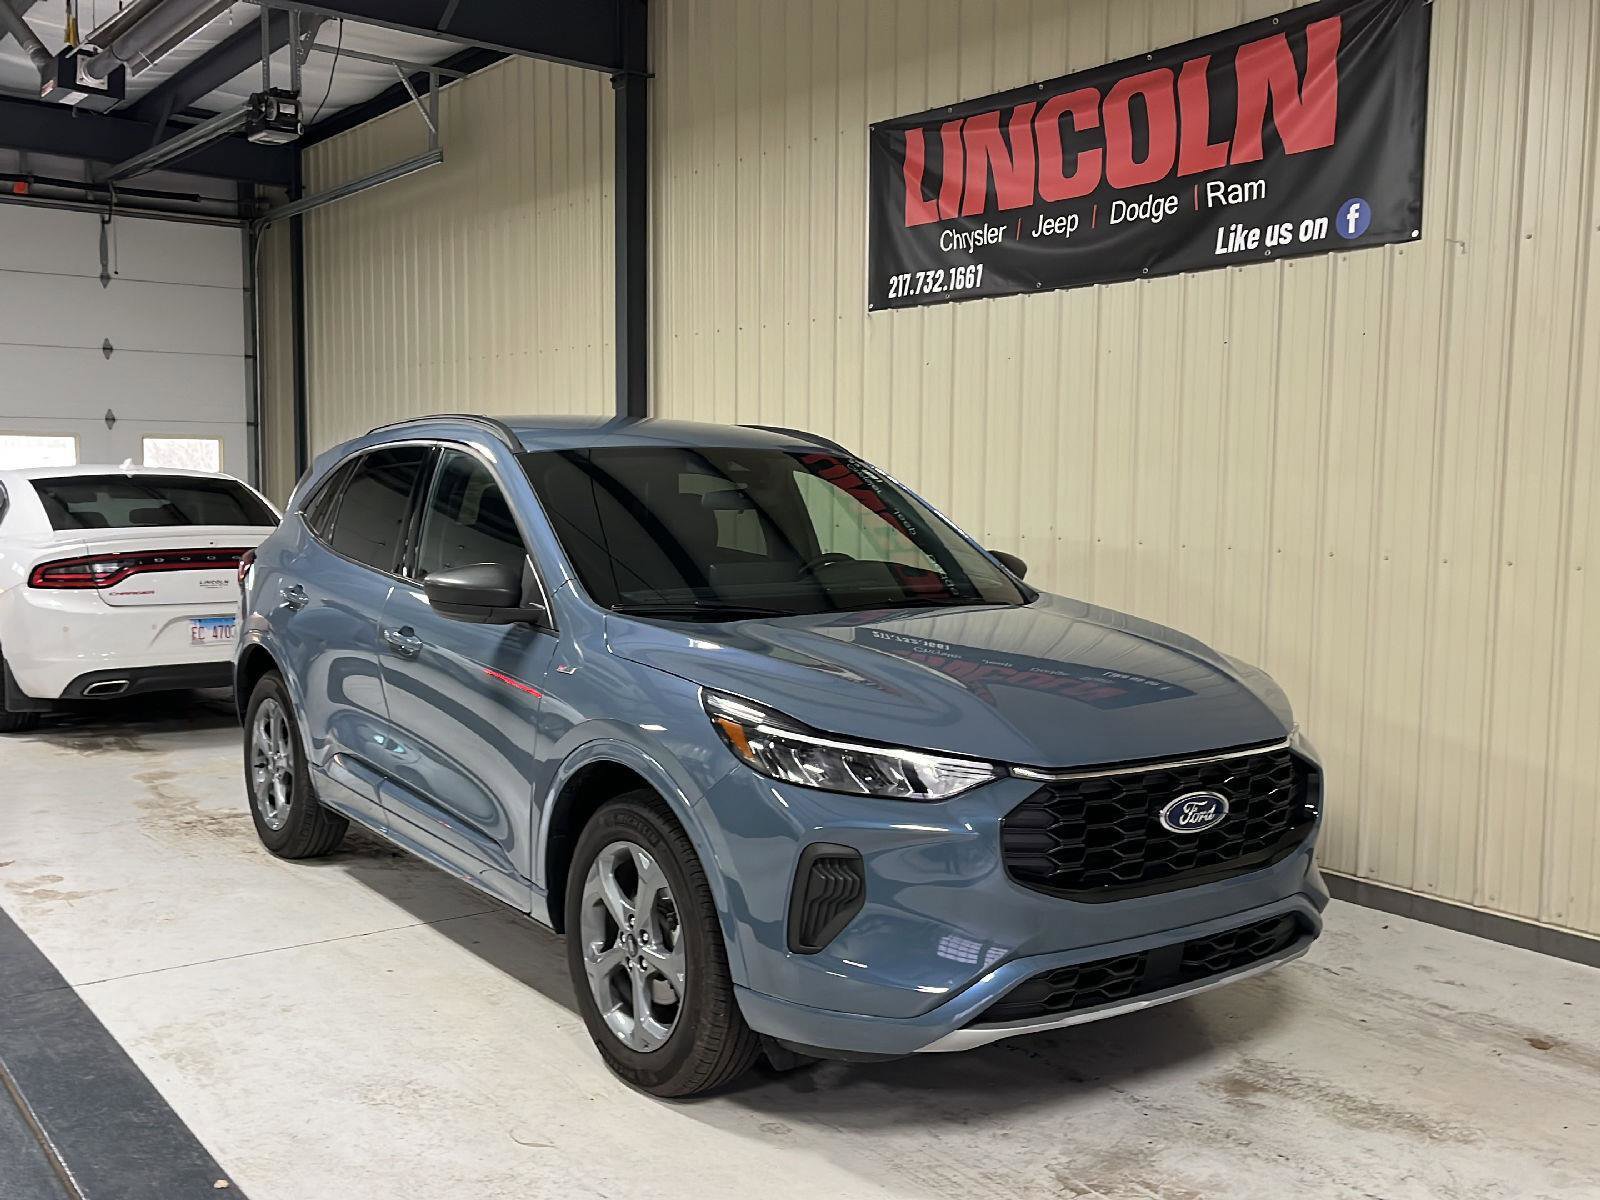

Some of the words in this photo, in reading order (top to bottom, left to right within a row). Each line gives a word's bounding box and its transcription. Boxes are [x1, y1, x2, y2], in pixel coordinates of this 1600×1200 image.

[904, 16, 1342, 228] LINCOLN
[939, 222, 1007, 253] Chrysler
[1032, 213, 1079, 239] Jeep
[1109, 194, 1179, 224] Dodge
[1206, 179, 1266, 208] Ram
[1215, 223, 1260, 255] Like
[1265, 222, 1293, 248] us
[1299, 217, 1329, 242] on
[888, 263, 984, 299] 217.732.1661
[212, 624, 236, 639] 470
[1178, 800, 1217, 826] Ford
